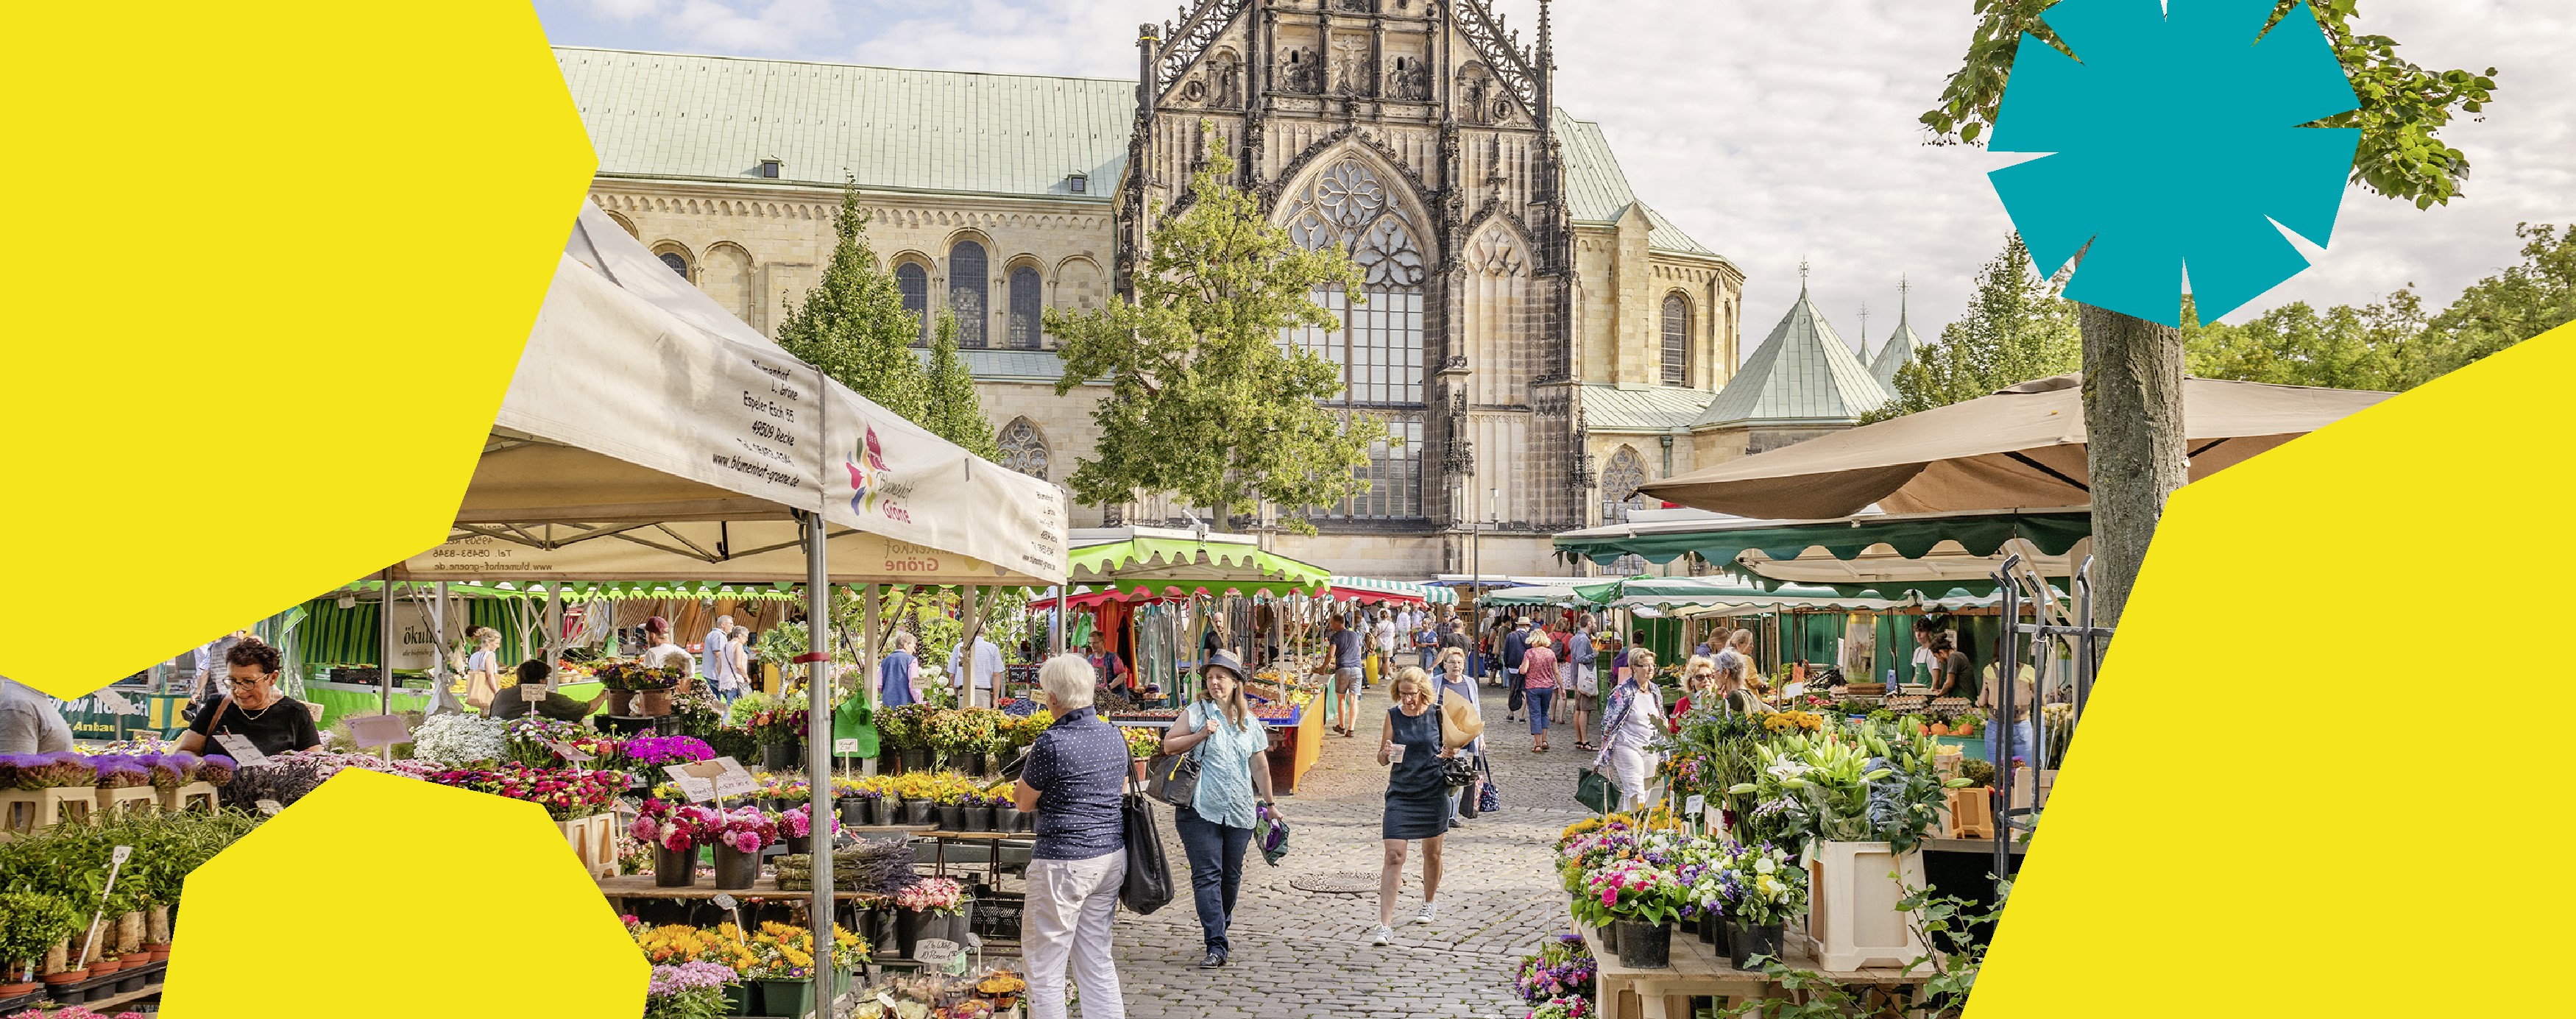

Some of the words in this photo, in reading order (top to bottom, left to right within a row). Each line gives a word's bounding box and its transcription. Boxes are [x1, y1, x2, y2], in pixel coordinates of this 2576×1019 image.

[743, 391, 767, 412] Espeler
[769, 401, 784, 420] Esch
[752, 420, 774, 439] 49509
[774, 427, 795, 446] Recke
[712, 453, 799, 487] www.blumenhof-groene.de
[876, 472, 915, 508] Blumenhof
[882, 499, 911, 524] Gröne
[73, 721, 115, 732] Anbau
